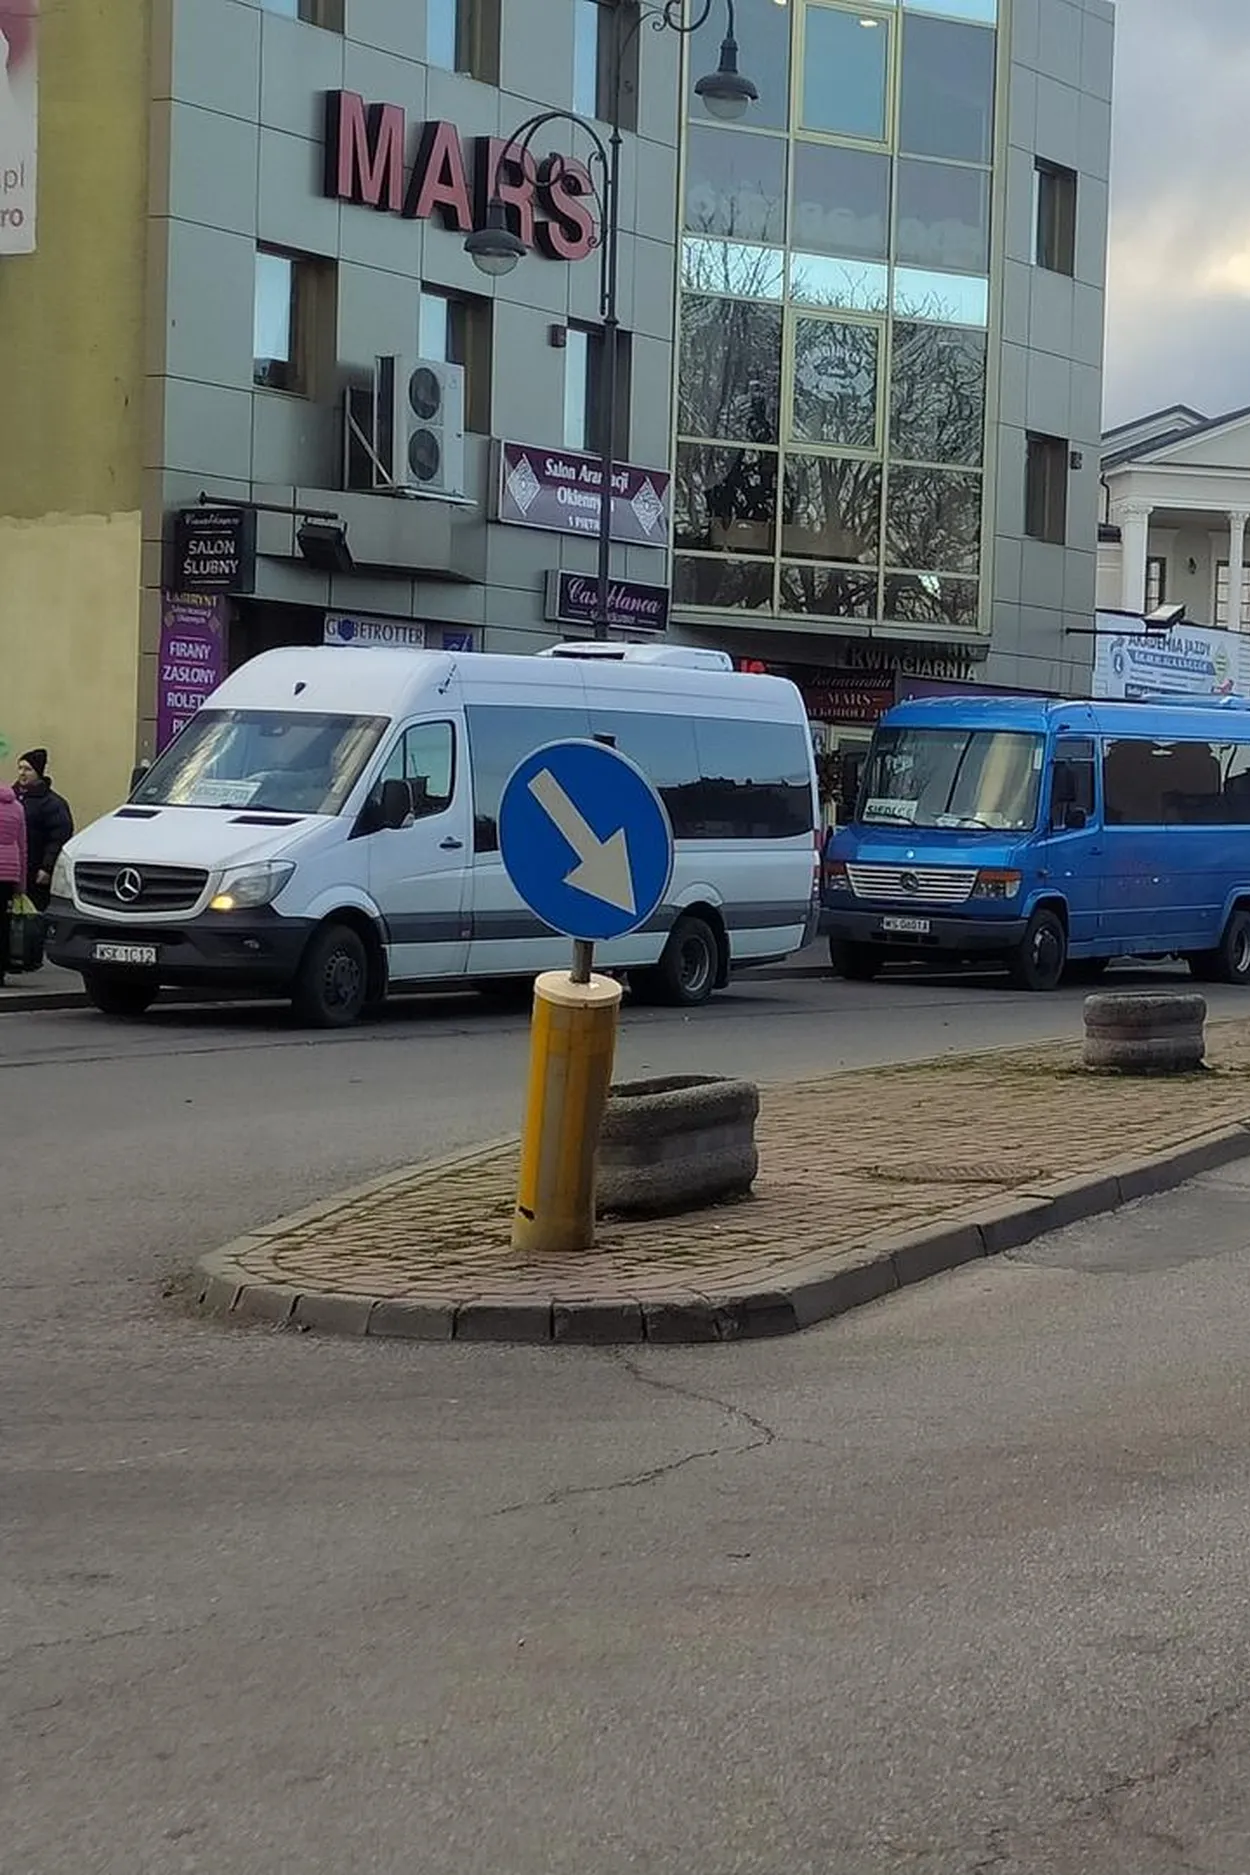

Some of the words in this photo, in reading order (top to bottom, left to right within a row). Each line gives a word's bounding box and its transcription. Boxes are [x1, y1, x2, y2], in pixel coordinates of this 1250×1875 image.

[325, 89, 596, 260] MARS
[545, 458, 576, 481] Salon
[578, 464, 630, 493] Aranacji
[557, 486, 614, 514] Okienny
[188, 540, 235, 555] SALON
[183, 557, 239, 575] ŚLUBNY
[567, 577, 660, 614] Casblanca
[326, 618, 423, 645] GBETROTTER
[169, 641, 211, 660] FIRANY
[851, 648, 978, 681] KWIACIARNIA
